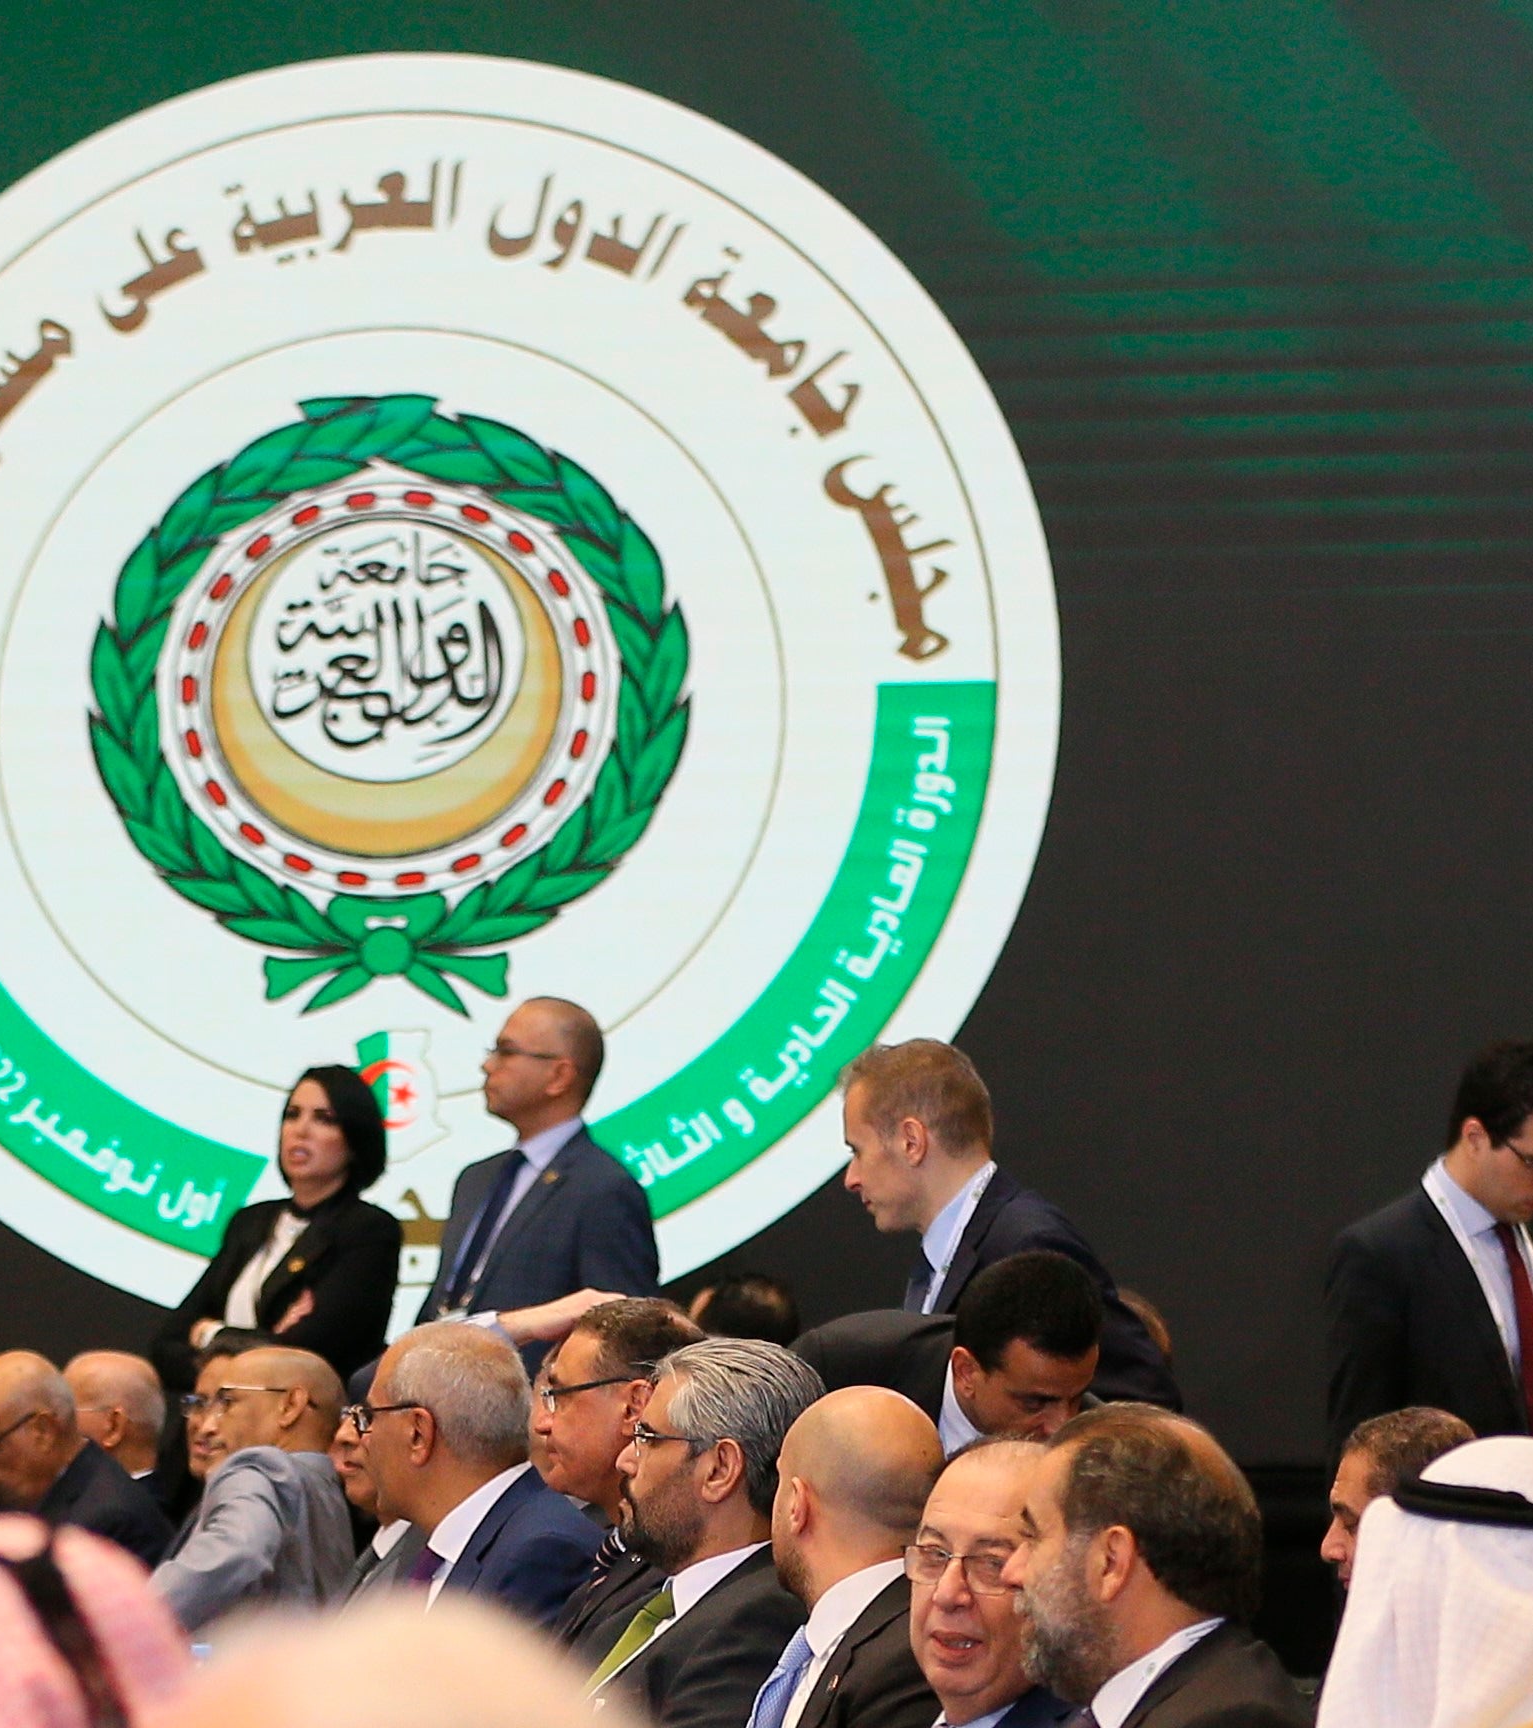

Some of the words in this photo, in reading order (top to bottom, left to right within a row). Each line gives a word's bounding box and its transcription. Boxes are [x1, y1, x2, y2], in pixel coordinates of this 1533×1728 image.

[225, 160, 461, 265] العربية
[486, 174, 685, 277] الدول
[99, 226, 207, 335] على
[682, 247, 860, 438] جامعة
[823, 456, 952, 661] مجلس
[897, 716, 956, 827] الدورة
[836, 839, 927, 979] العادية
[741, 980, 857, 1101] الحادية
[8, 1098, 159, 1195] نوفمبر
[625, 1112, 722, 1187] الثلاث
[157, 1178, 225, 1229] أول
